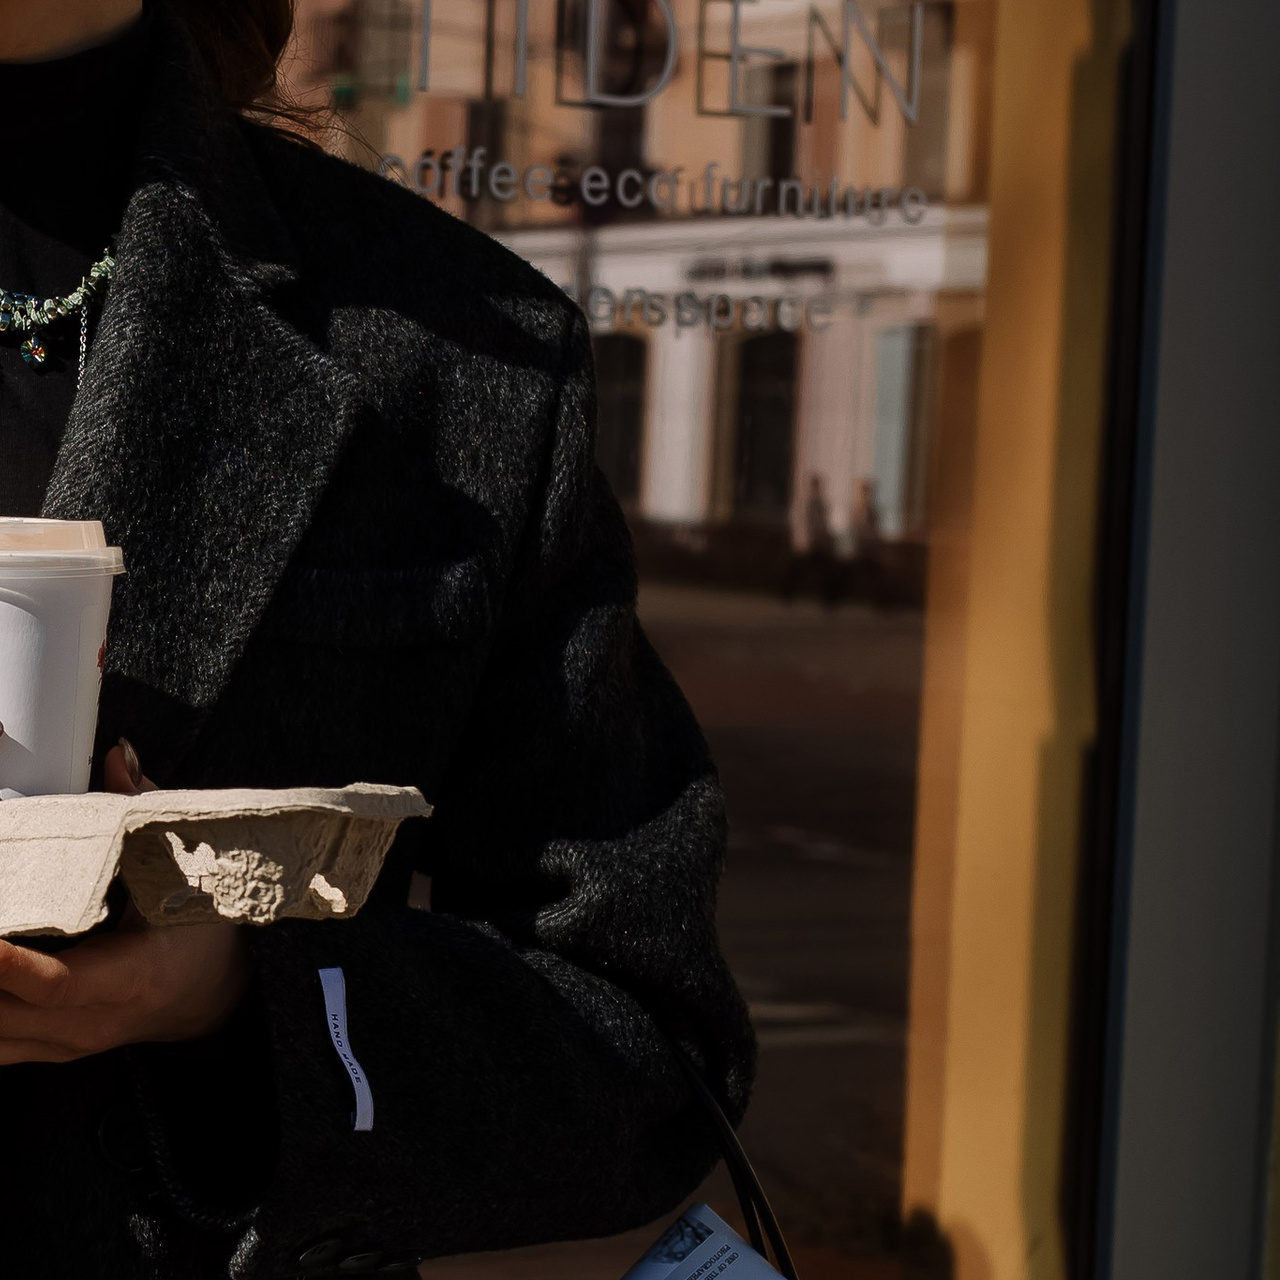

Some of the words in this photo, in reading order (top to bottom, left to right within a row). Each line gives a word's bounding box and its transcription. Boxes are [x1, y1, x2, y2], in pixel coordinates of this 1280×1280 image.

[331, 1013, 343, 1048] HAND
[342, 1053, 361, 1083] MADE
[724, 1251, 739, 1265] ONE
[716, 1262, 727, 1273] OF
